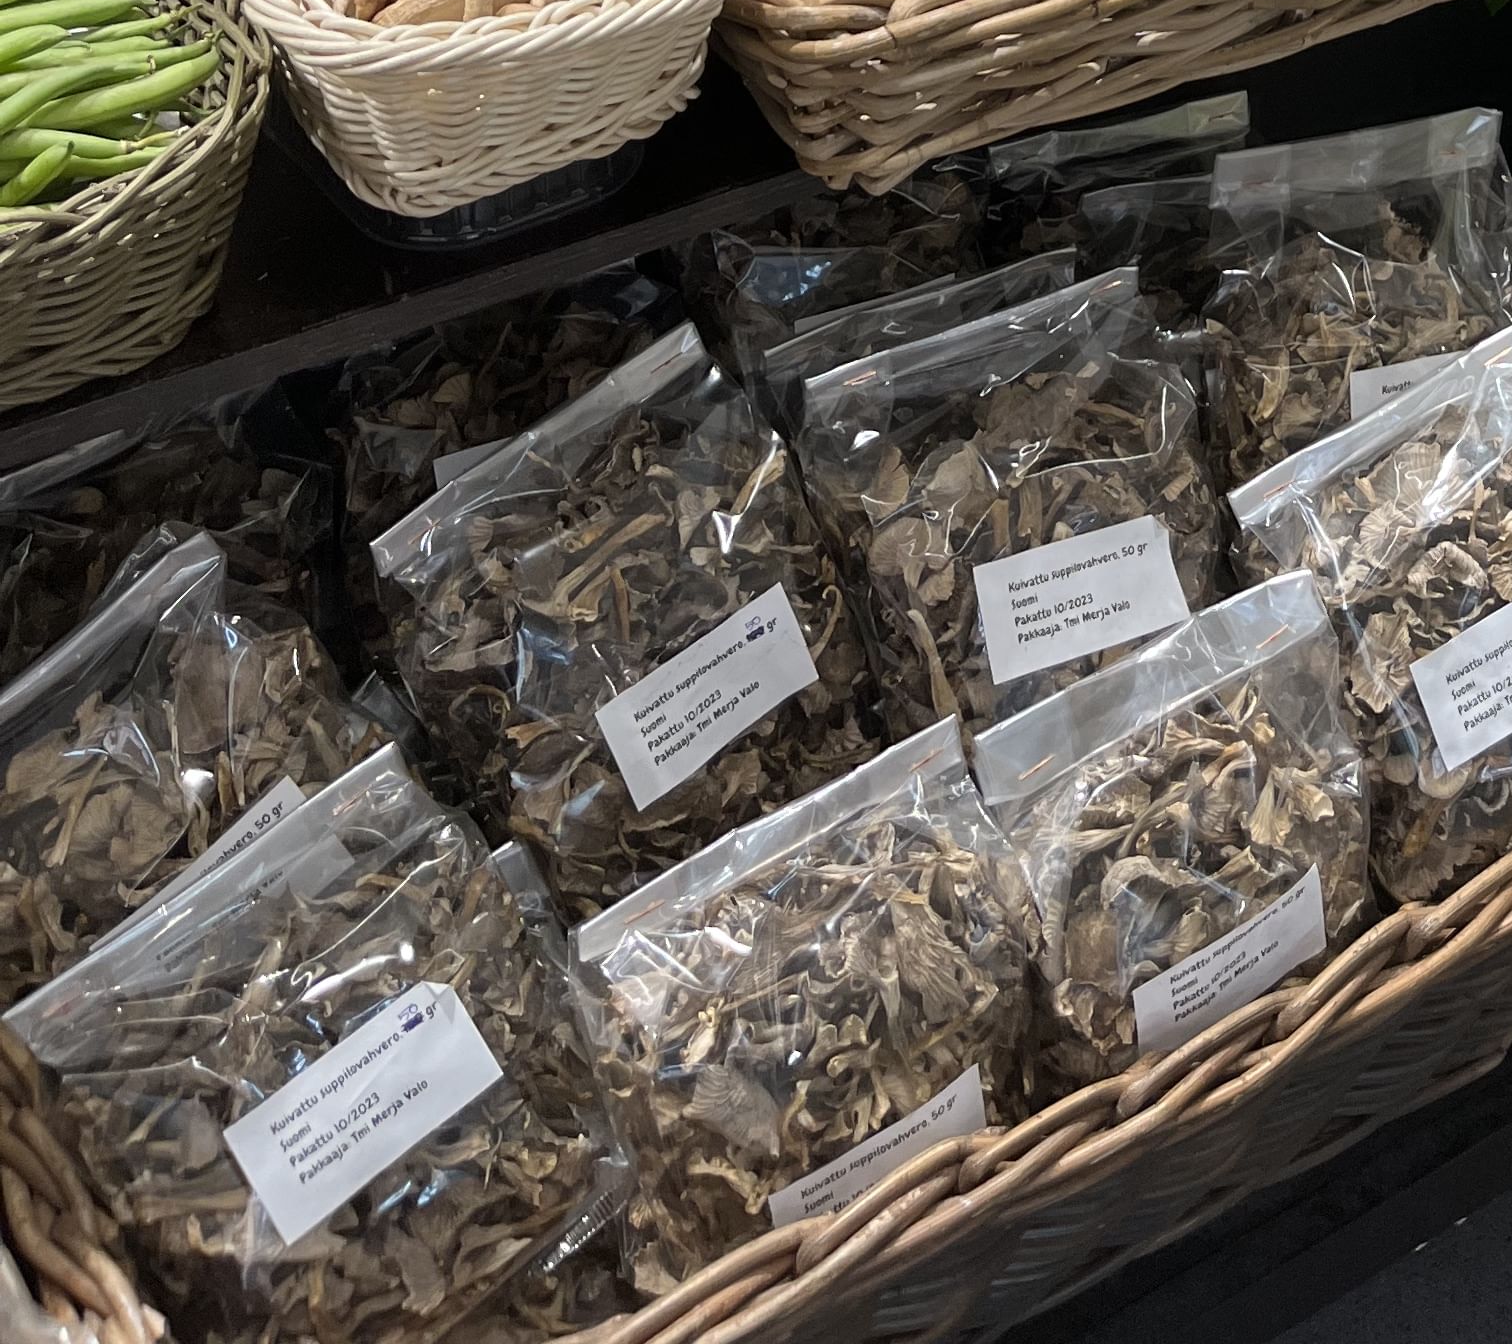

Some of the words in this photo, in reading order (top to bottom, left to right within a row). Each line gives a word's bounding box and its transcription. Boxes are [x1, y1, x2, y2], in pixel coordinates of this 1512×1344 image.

[1007, 574, 1050, 593] Kuivattu
[1121, 543, 1135, 557] 50
[1136, 542, 1148, 557] gr
[1010, 594, 1039, 611] Suomi
[1015, 606, 1052, 627] Pakattu
[1054, 593, 1094, 614] 10/2023
[1064, 615, 1080, 629] Tmi
[1082, 605, 1110, 622] Merja
[1111, 599, 1131, 614] Valo
[633, 687, 675, 723] Kuivattu
[765, 616, 779, 634] gr
[1446, 657, 1483, 686] Kuivattu
[697, 715, 713, 735] Tmi
[712, 696, 740, 725] Merja
[738, 679, 760, 700] Valo
[1451, 682, 1476, 702] Suomi
[1457, 689, 1492, 716] Pakattu
[640, 714, 668, 738] Suomi
[647, 720, 685, 752] Pakattu
[684, 689, 723, 724] 10/2023
[1463, 702, 1505, 732] Pakkaaja:
[254, 813, 271, 830] 50
[271, 800, 285, 818] gr
[1169, 957, 1211, 985] Kuivattu
[1294, 885, 1306, 900] gr
[1218, 976, 1233, 992] Tmi
[1233, 956, 1260, 980] Merja
[1260, 940, 1280, 959] Valo
[1171, 977, 1198, 998] Suomi
[1173, 983, 1210, 1010] Pakattu
[269, 1092, 318, 1135] Kuivattu
[426, 1000, 440, 1020] gr
[350, 1124, 371, 1145] Tmi
[371, 1099, 404, 1127] Merja
[403, 1078, 430, 1100] Valo
[279, 1124, 312, 1153] Suomi
[289, 1129, 335, 1168] Pakattu
[334, 1091, 381, 1133] 10/2023
[799, 1165, 848, 1200] Kuivattu
[930, 1105, 946, 1121] 50
[945, 1093, 958, 1112] gr
[803, 1191, 834, 1214] Suomi
